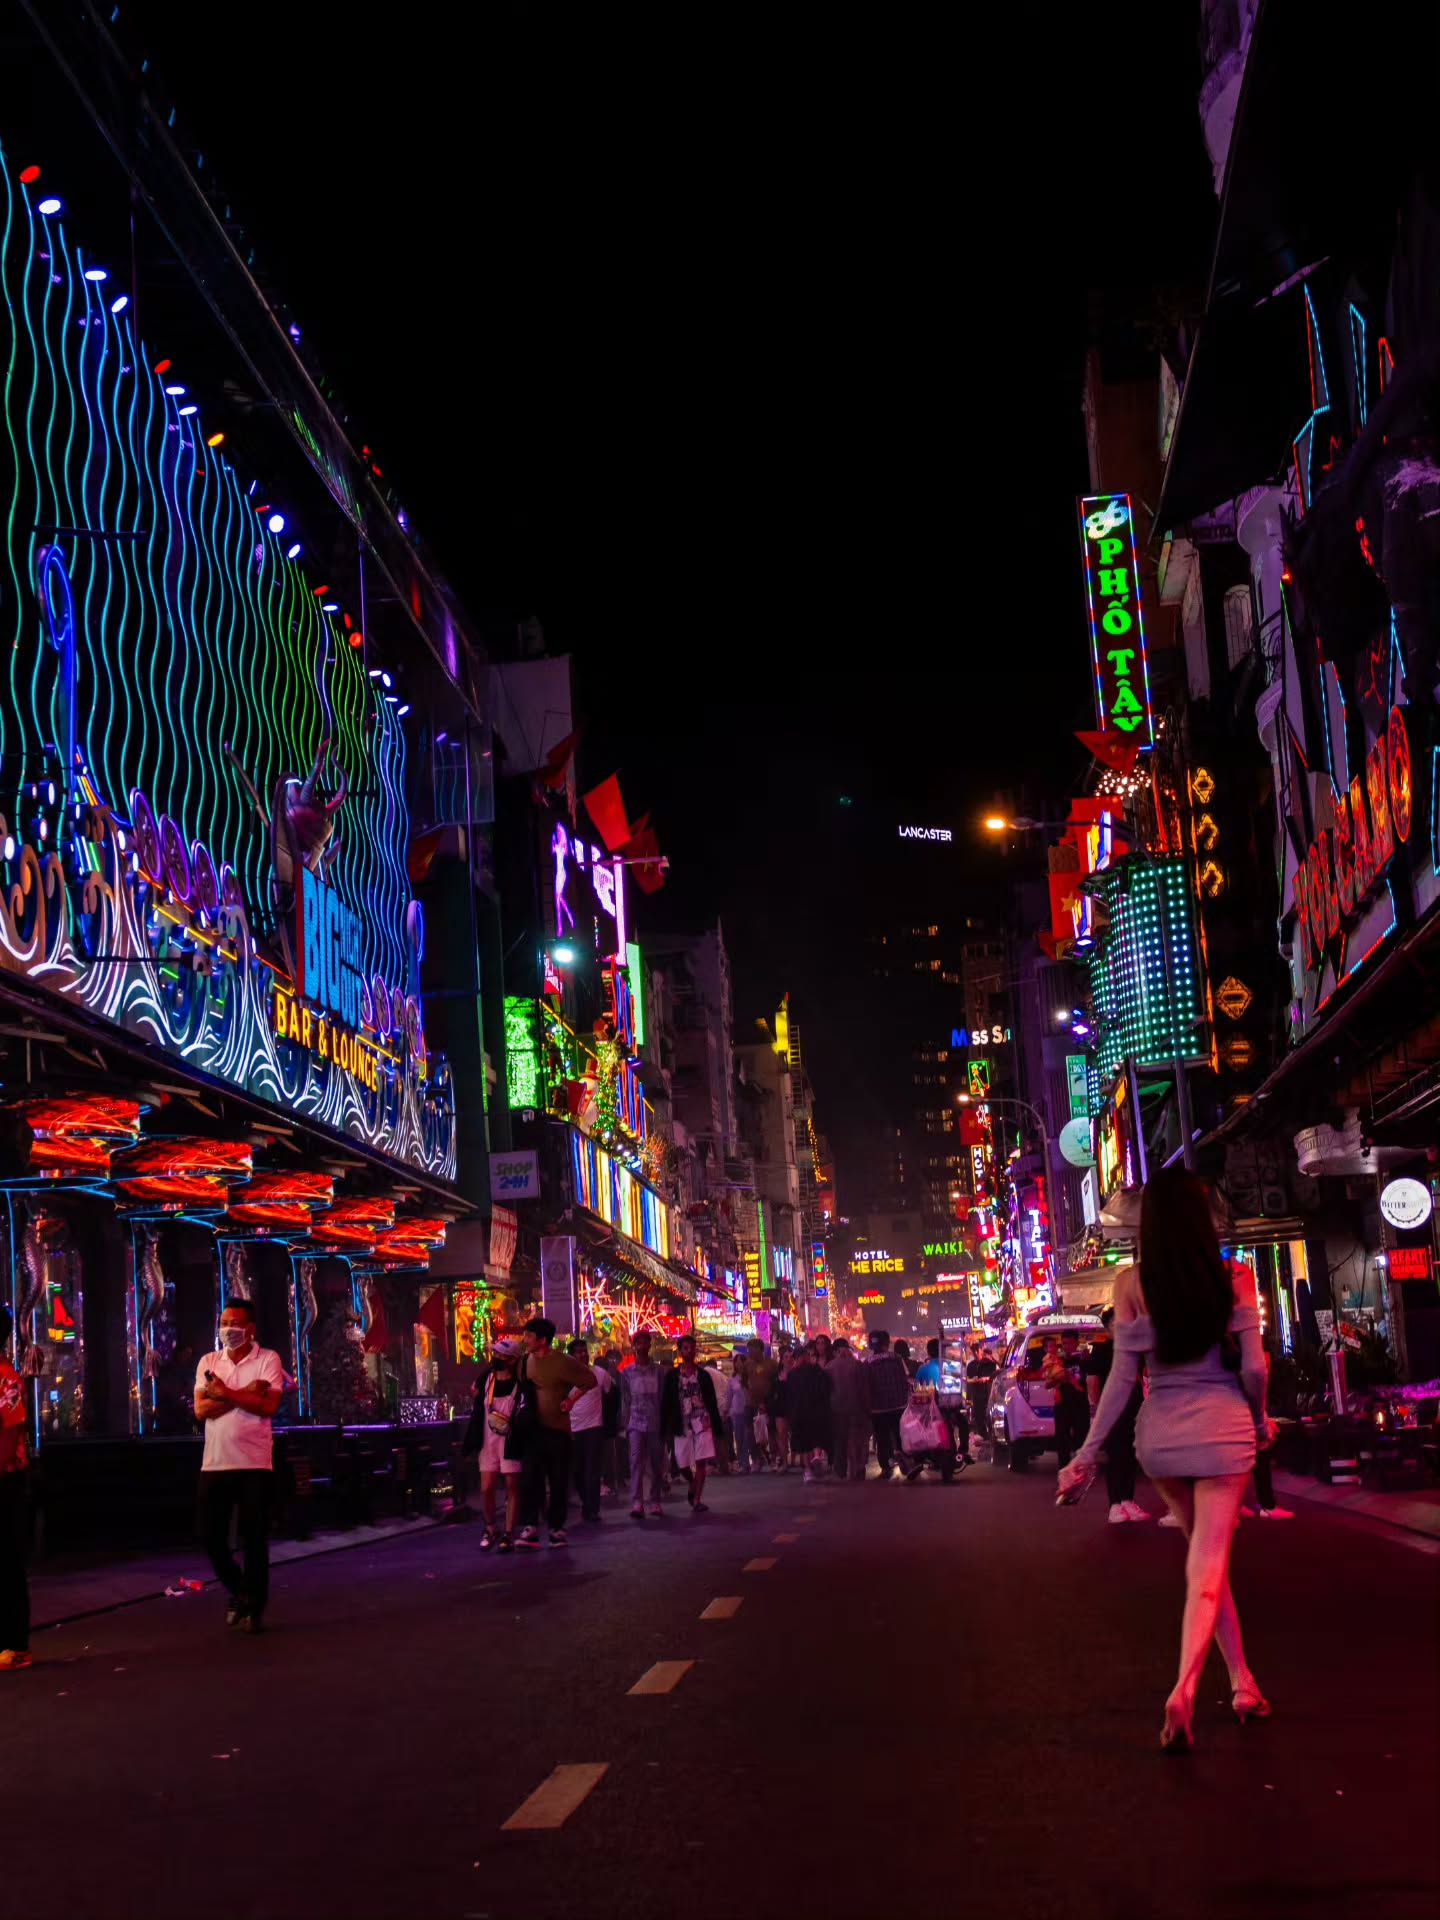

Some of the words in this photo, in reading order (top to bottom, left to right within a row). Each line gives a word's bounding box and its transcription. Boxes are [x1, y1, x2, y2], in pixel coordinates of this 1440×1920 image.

[1097, 538, 1132, 634] PHỐ
[1107, 648, 1143, 731] TÂY
[899, 825, 952, 841] LANCASTER
[1293, 704, 1411, 970] VOLCANO
[303, 865, 340, 1013] BIG
[341, 963, 363, 1033] OUT
[276, 992, 311, 1049] BAR
[318, 1018, 328, 1057] &
[333, 1026, 378, 1092] LOUNGE
[495, 1162, 532, 1177] SHOP
[499, 1175, 529, 1190] 24H
[849, 1260, 870, 1274] HE
[872, 1258, 904, 1273] RICE
[855, 1250, 890, 1260] HOTEL
[970, 1275, 982, 1328] HOTEL
